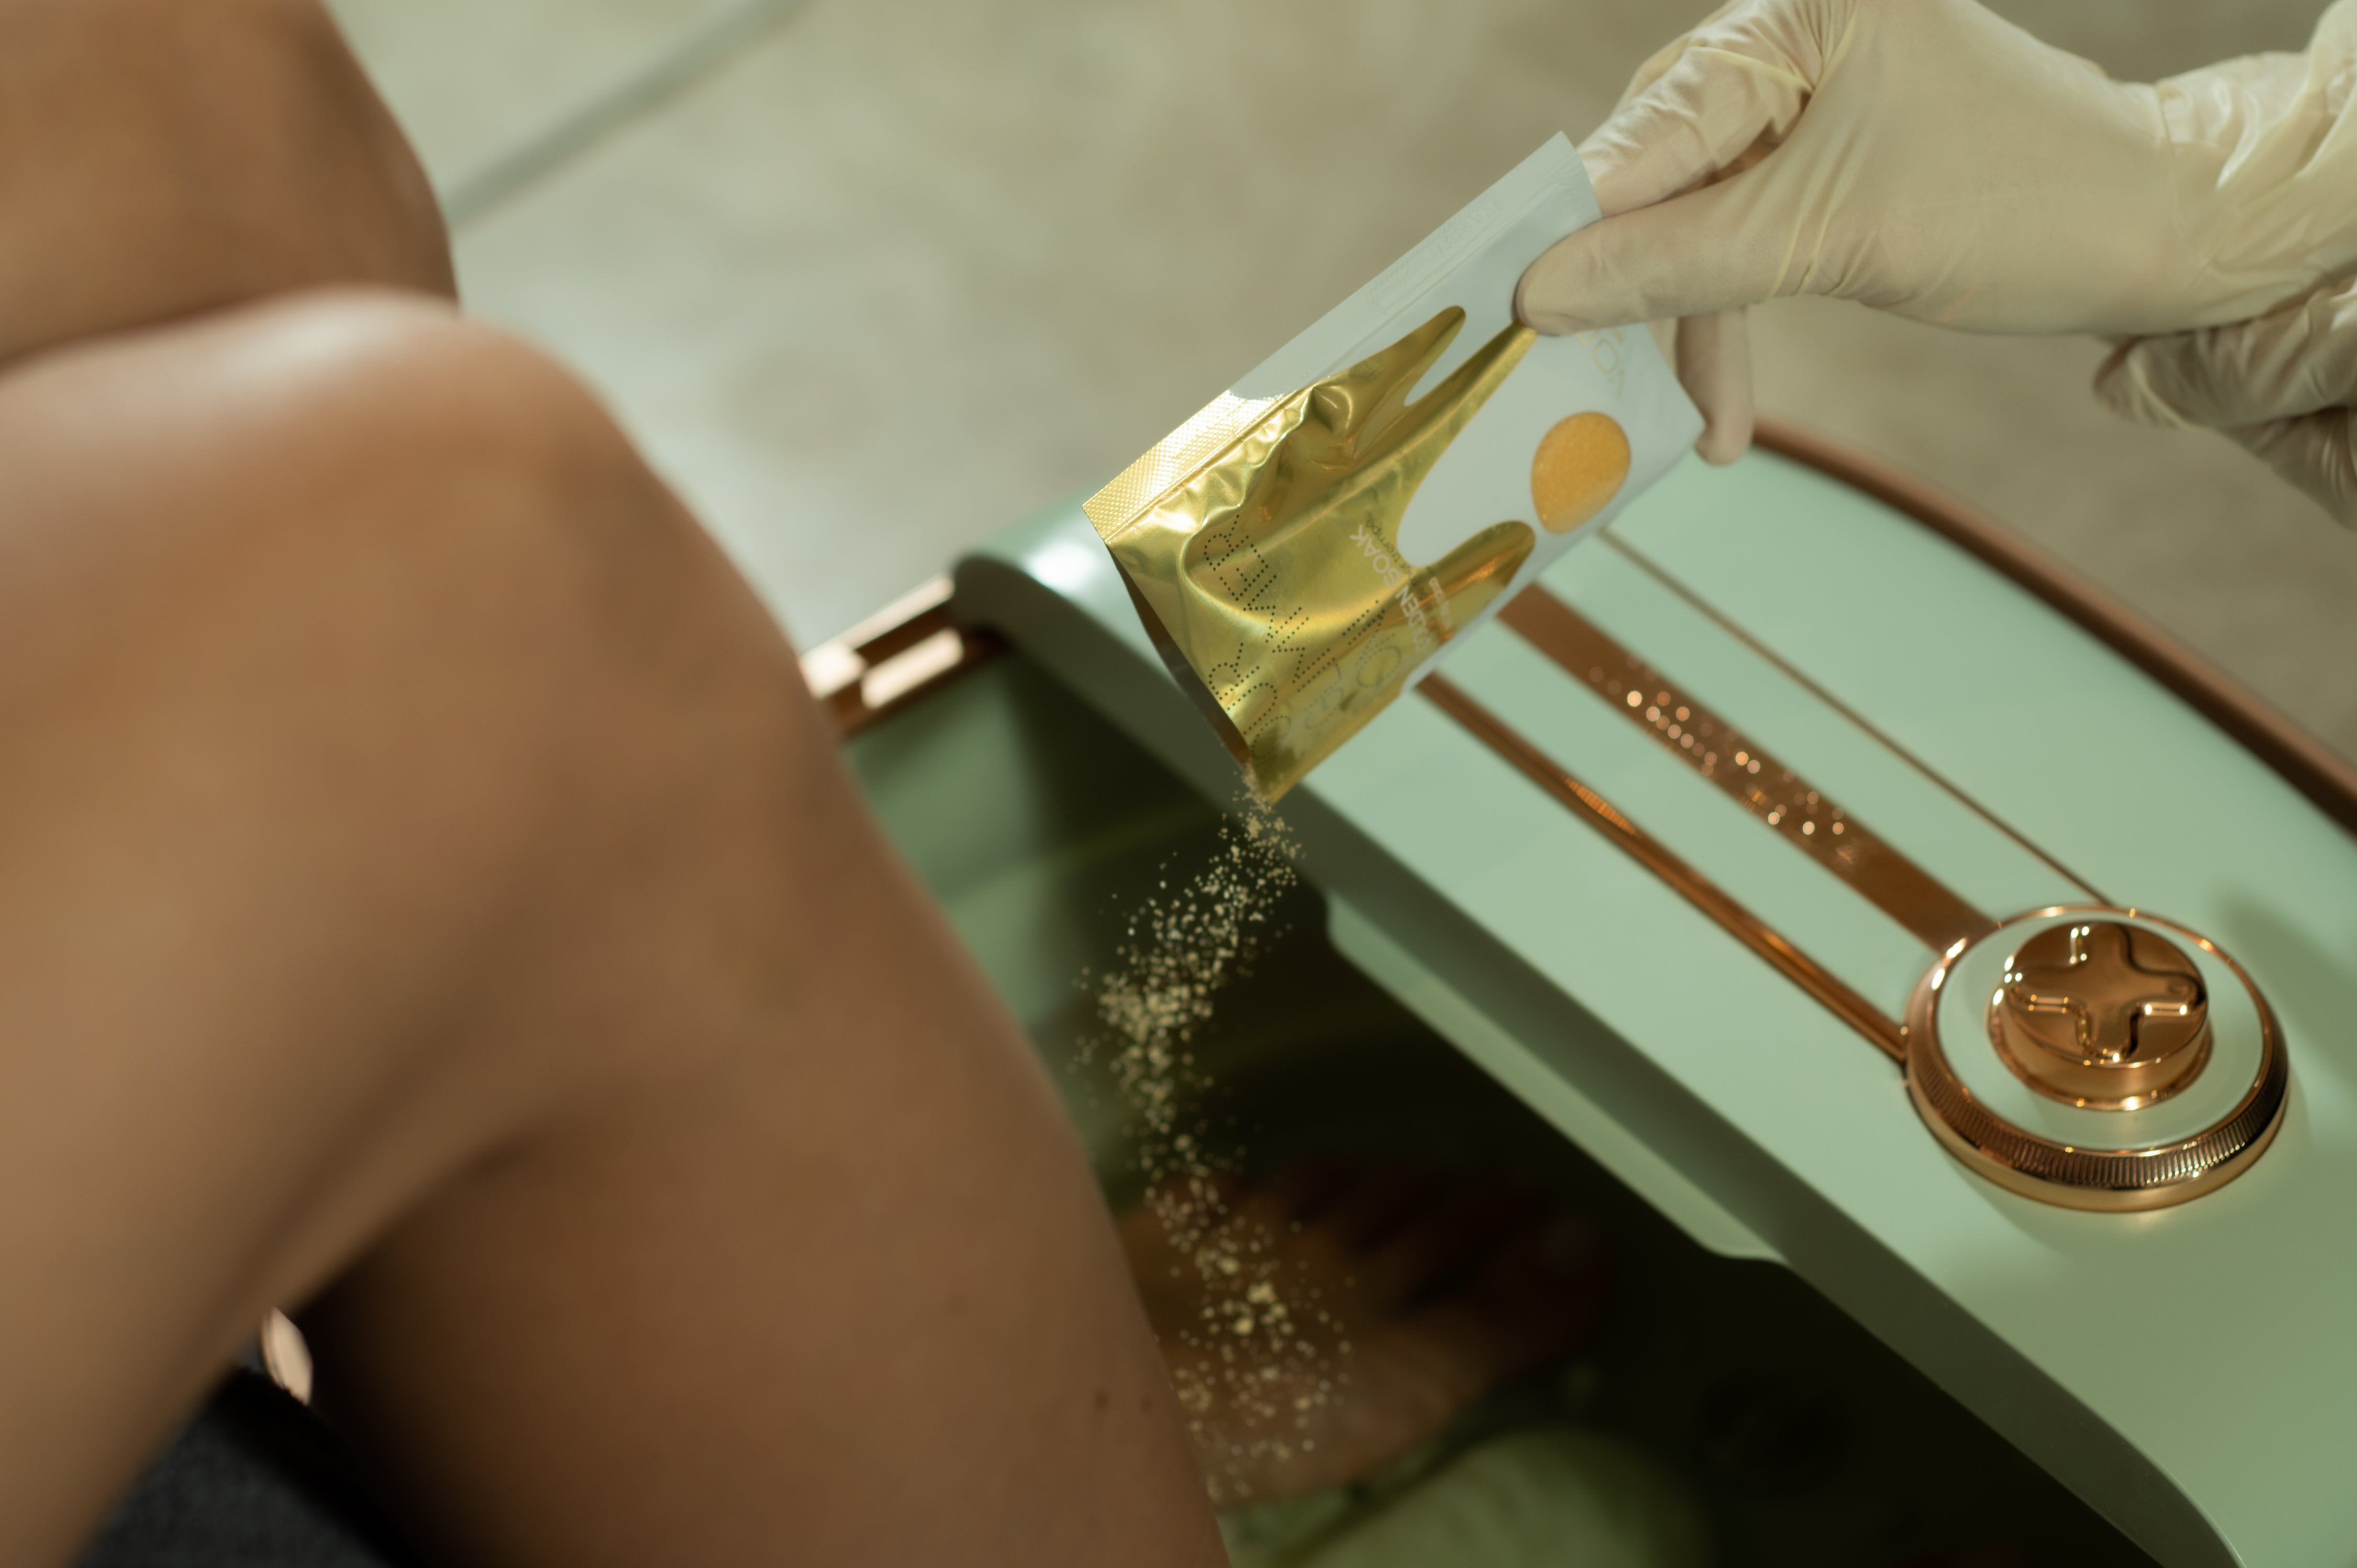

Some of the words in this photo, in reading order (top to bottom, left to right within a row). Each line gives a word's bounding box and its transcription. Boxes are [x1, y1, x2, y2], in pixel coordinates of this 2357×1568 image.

[1349, 524, 1402, 589] SOAK
[1203, 514, 1344, 730] GLIMMER
[1394, 584, 1431, 654] GOLDEN
